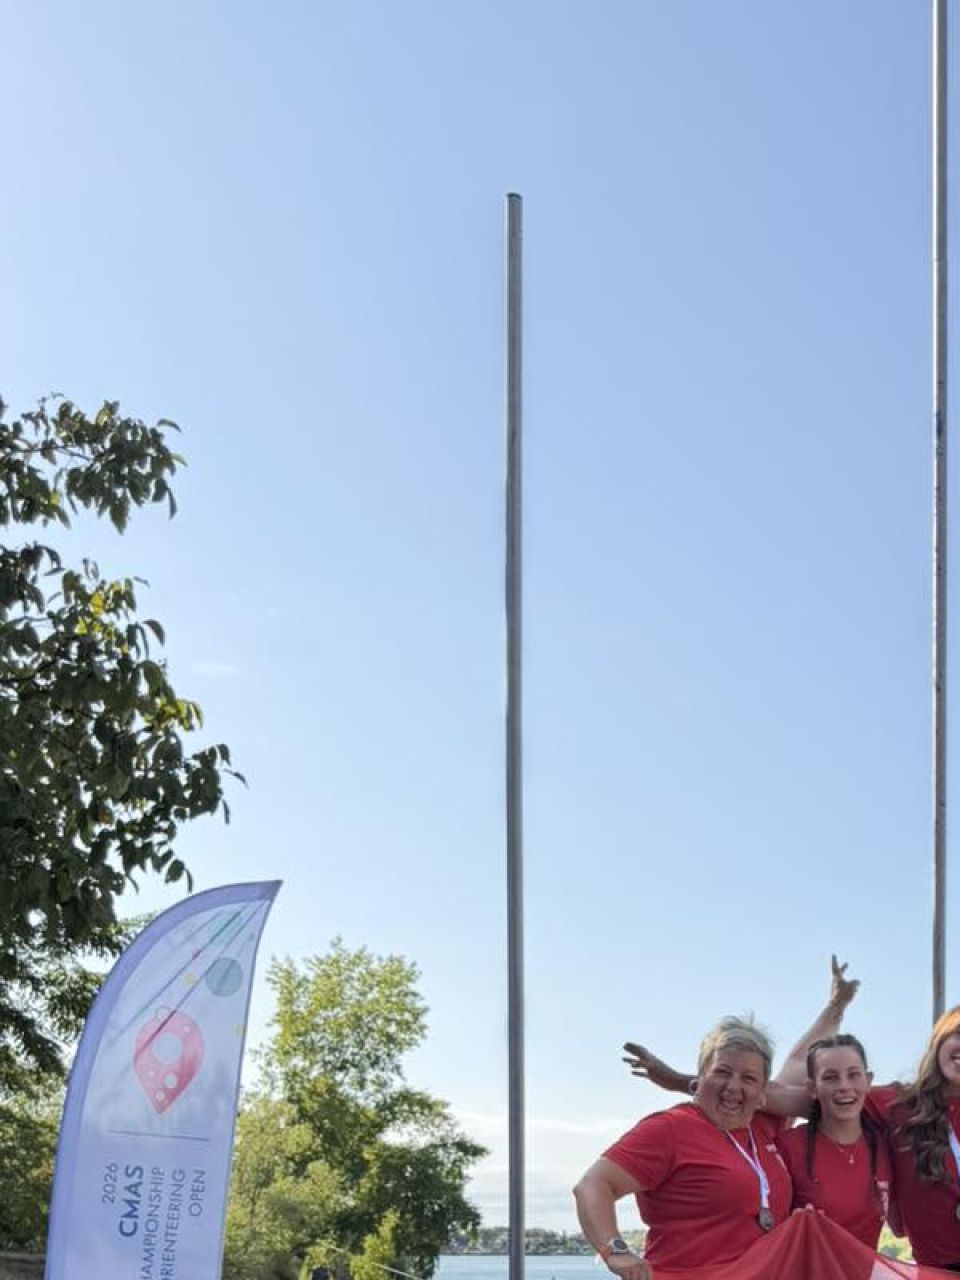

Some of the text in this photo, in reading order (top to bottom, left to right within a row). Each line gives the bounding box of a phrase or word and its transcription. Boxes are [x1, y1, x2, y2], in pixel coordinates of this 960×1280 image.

[102, 1162, 119, 1204] 2026
[119, 1164, 144, 1238] CMAS
[188, 1169, 206, 1217] OPEN
